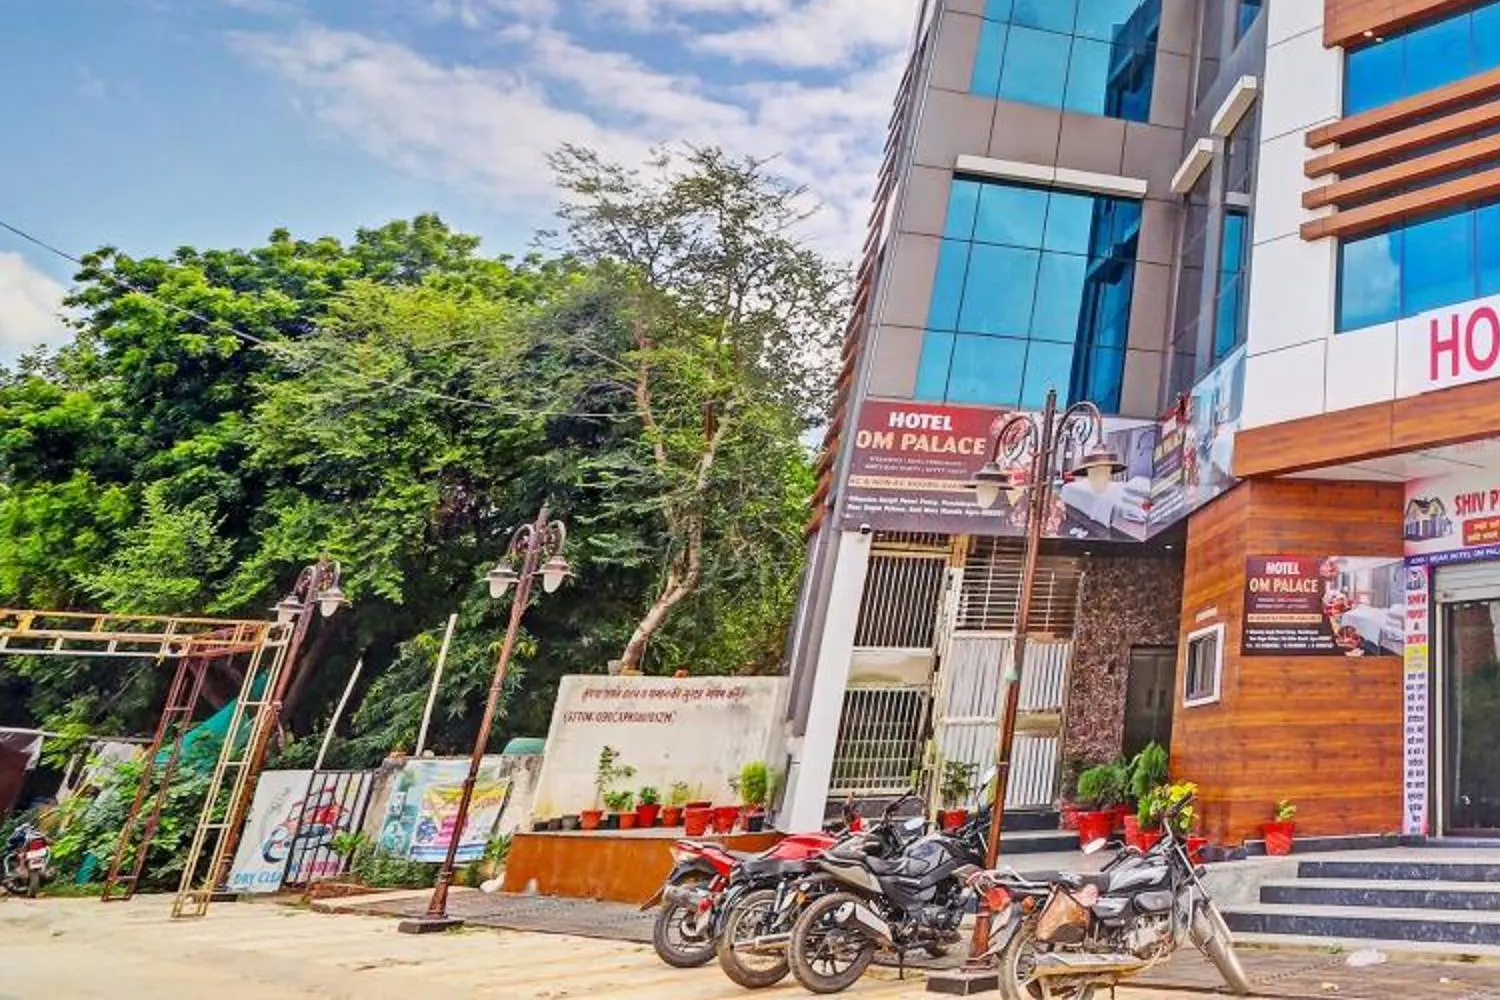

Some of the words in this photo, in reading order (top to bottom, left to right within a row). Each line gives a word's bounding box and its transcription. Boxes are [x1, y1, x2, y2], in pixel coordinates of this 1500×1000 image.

[889, 412, 952, 431] HOTEL
[856, 429, 893, 450] OM
[901, 432, 986, 455] PALACE
[1455, 491, 1487, 517] SHIV
[1265, 561, 1301, 575] HOTEL
[1250, 578, 1272, 593] OM
[1273, 578, 1318, 593] PALACE
